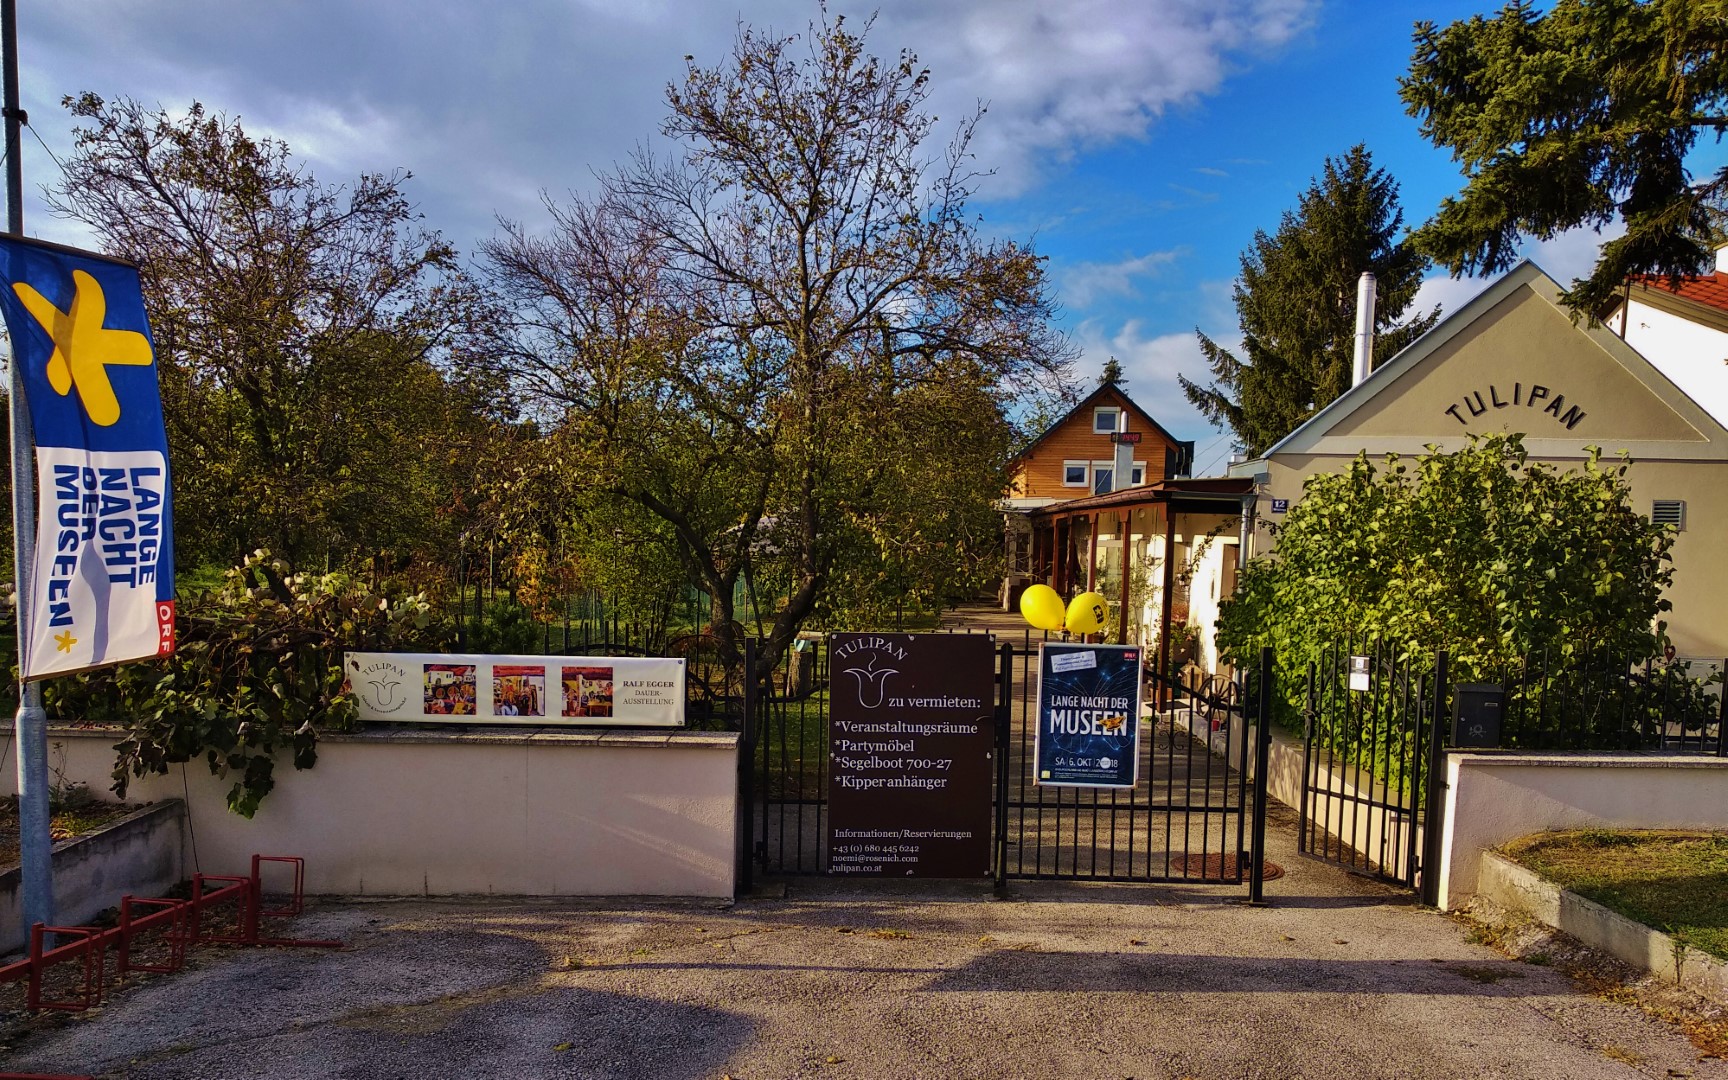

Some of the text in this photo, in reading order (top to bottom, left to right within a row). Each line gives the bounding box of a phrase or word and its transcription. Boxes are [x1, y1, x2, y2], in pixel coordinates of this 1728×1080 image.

[1445, 382, 1587, 430] TULIPAN
[81, 467, 99, 541] DER
[1275, 500, 1286, 508] 12
[98, 468, 136, 588] NACHT
[130, 467, 161, 585] LANGE
[48, 464, 80, 627] MUSEEN
[159, 605, 172, 651] ORF
[835, 636, 908, 661] TULIPAN
[362, 662, 406, 677] TULIPAN
[888, 694, 981, 708] zu vermieten:
[1051, 694, 1128, 709] LANGE NACHT DER
[906, 759, 952, 771] 700-27
[1055, 756, 1066, 766] SA
[1069, 757, 1076, 766] 6.
[1077, 757, 1092, 767] OKT
[834, 829, 972, 840] Informationen/Reservierungen
[832, 845, 848, 853] +43
[882, 845, 898, 853] 445
[899, 845, 919, 853] 6242
[832, 864, 882, 873] tulipan.co.at
